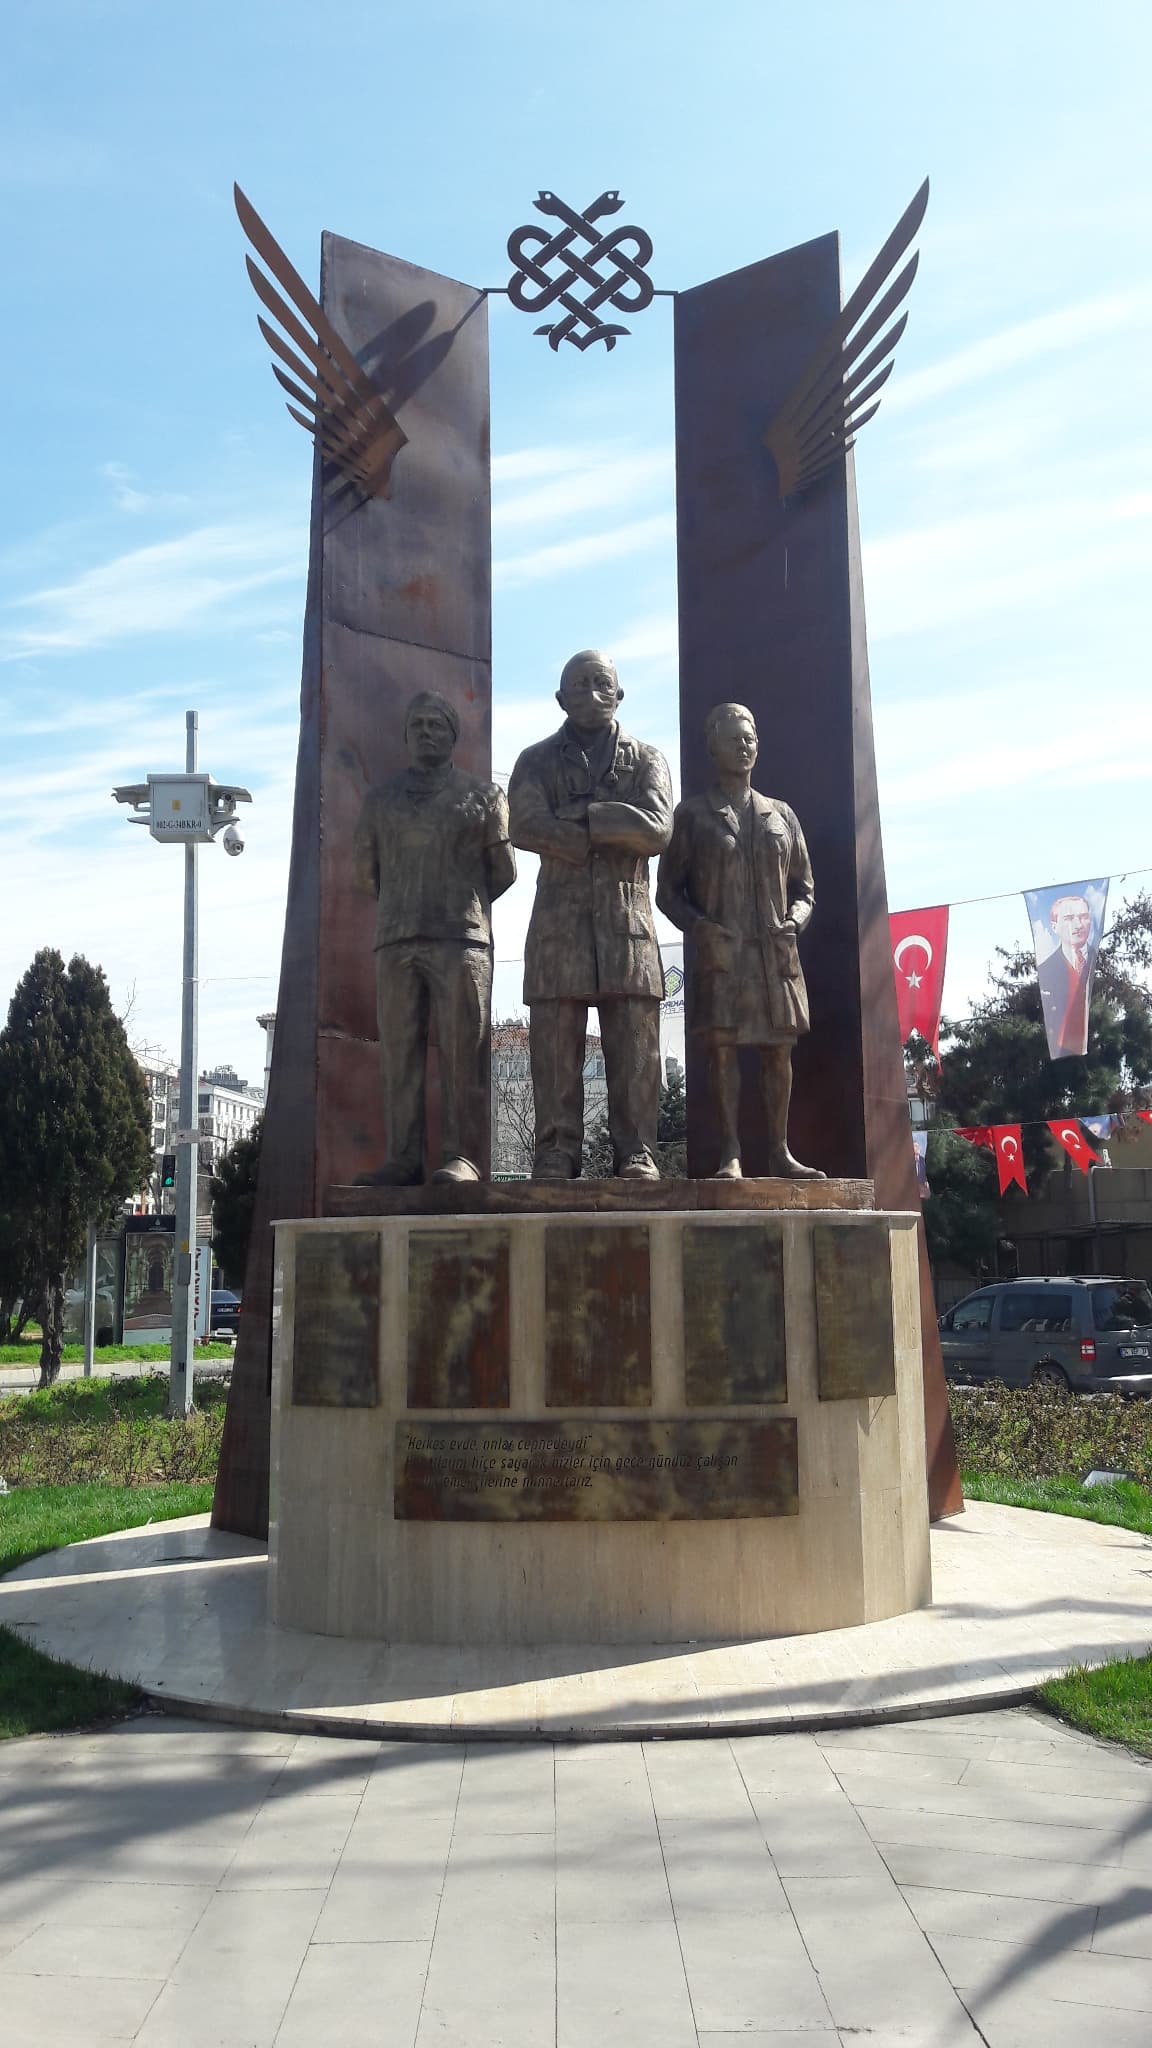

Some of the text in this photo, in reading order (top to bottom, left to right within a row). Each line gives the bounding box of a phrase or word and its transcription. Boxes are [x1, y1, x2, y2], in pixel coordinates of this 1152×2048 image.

[472, 1455, 496, 1472] hiçe
[588, 1455, 611, 1472] için
[615, 1455, 644, 1471] gece
[696, 1453, 738, 1471] çalışan
